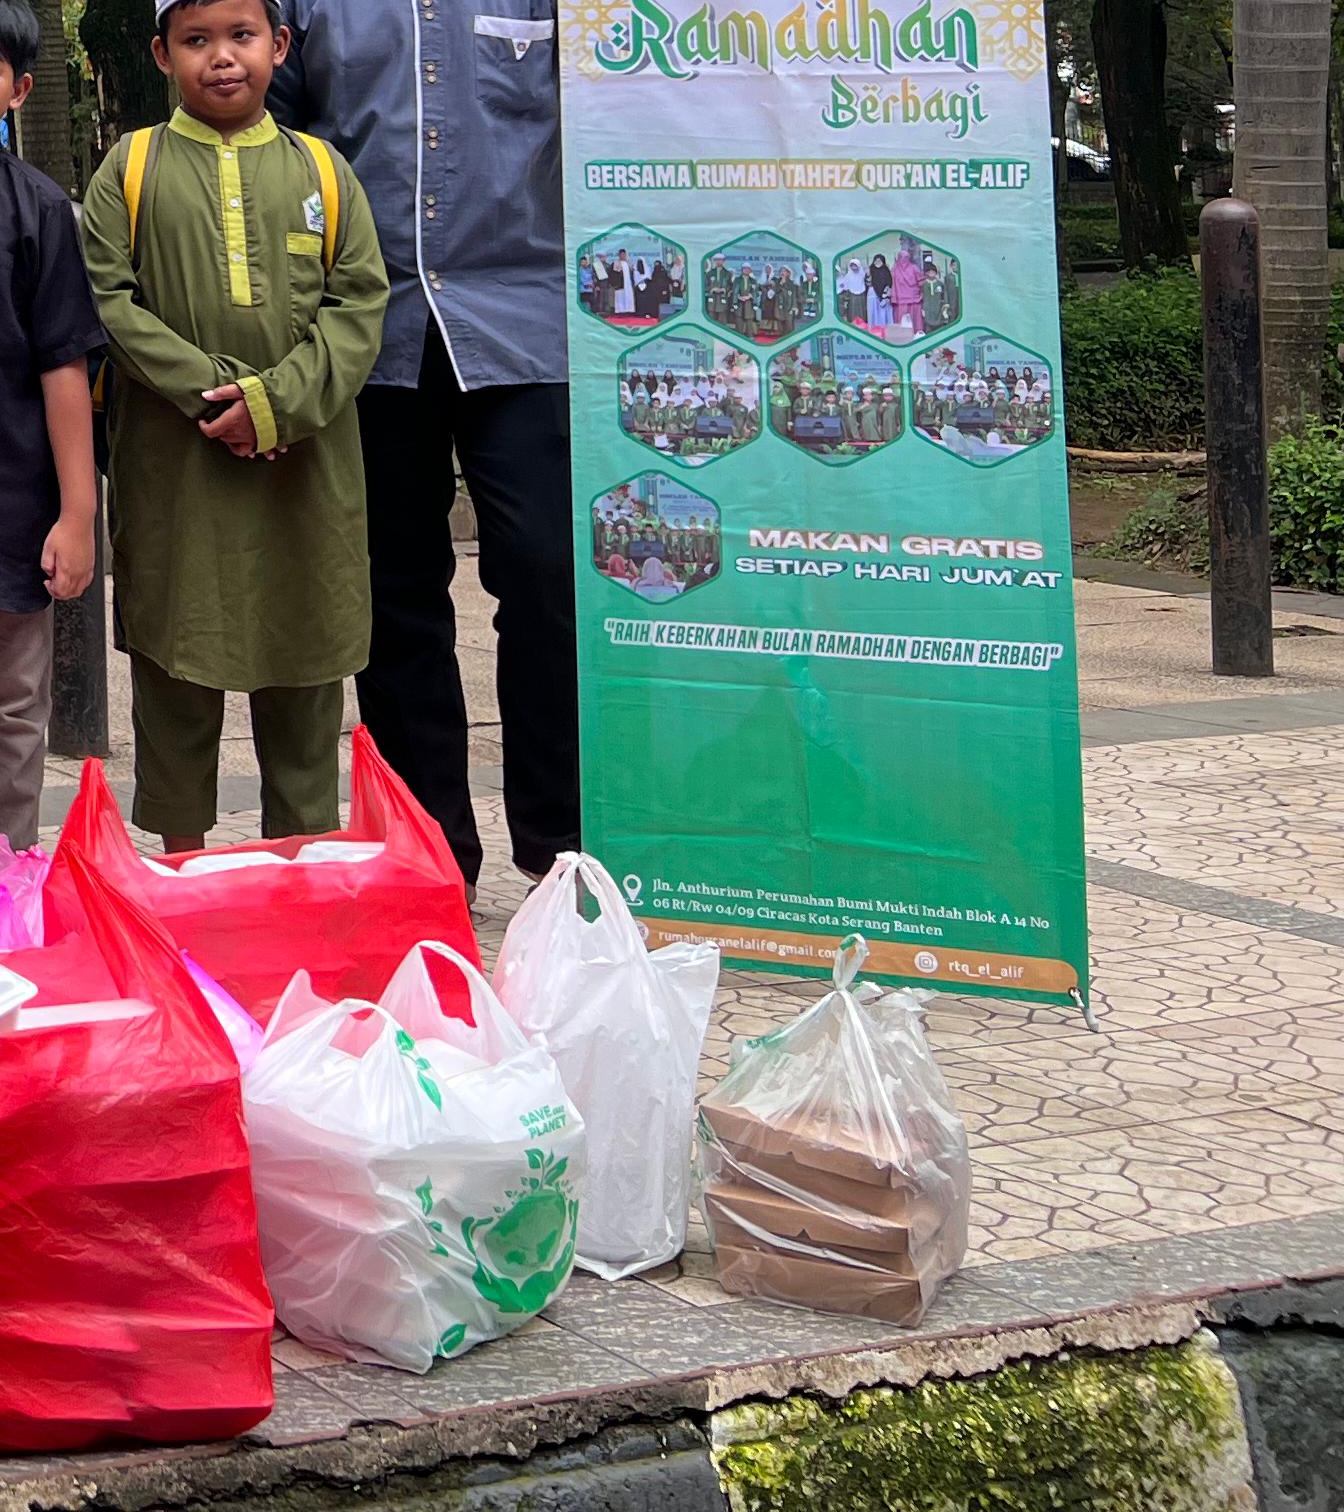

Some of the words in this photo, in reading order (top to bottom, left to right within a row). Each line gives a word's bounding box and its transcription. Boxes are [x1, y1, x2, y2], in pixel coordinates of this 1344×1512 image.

[586, 163, 692, 188] BERSAMA
[696, 163, 778, 188] RUMAH
[781, 163, 857, 188] TAHFIZ
[861, 163, 940, 190] QUR'AN
[945, 163, 1029, 188] EL-ALIF
[748, 529, 889, 553] MAKAN
[900, 536, 1044, 560] GRATIS
[735, 558, 844, 577] SETIAP
[854, 563, 930, 582] HARI
[654, 624, 759, 650] KEBERKAHAN
[762, 631, 812, 653] BULAN
[815, 634, 907, 659] RAMADHAN
[911, 639, 975, 663] DENGAN
[653, 898, 670, 909] 06
[715, 904, 754, 919] 04/09
[757, 907, 806, 923] Ciracas
[809, 912, 839, 926] Kota
[842, 916, 890, 934] Serang
[894, 920, 943, 936] Banten
[677, 881, 753, 900] Anthurium
[756, 889, 834, 907] Perumahan
[837, 897, 873, 911] Bumi
[876, 900, 919, 916] Mukti
[922, 905, 962, 920] Indah
[966, 909, 997, 924] Blok
[1000, 912, 1011, 926] A
[1014, 916, 1027, 928] 14
[1030, 916, 1050, 929] No
[949, 961, 1024, 979] rtq_el_alif
[519, 1104, 550, 1127] SAVE
[528, 1114, 566, 1139] PLANET
